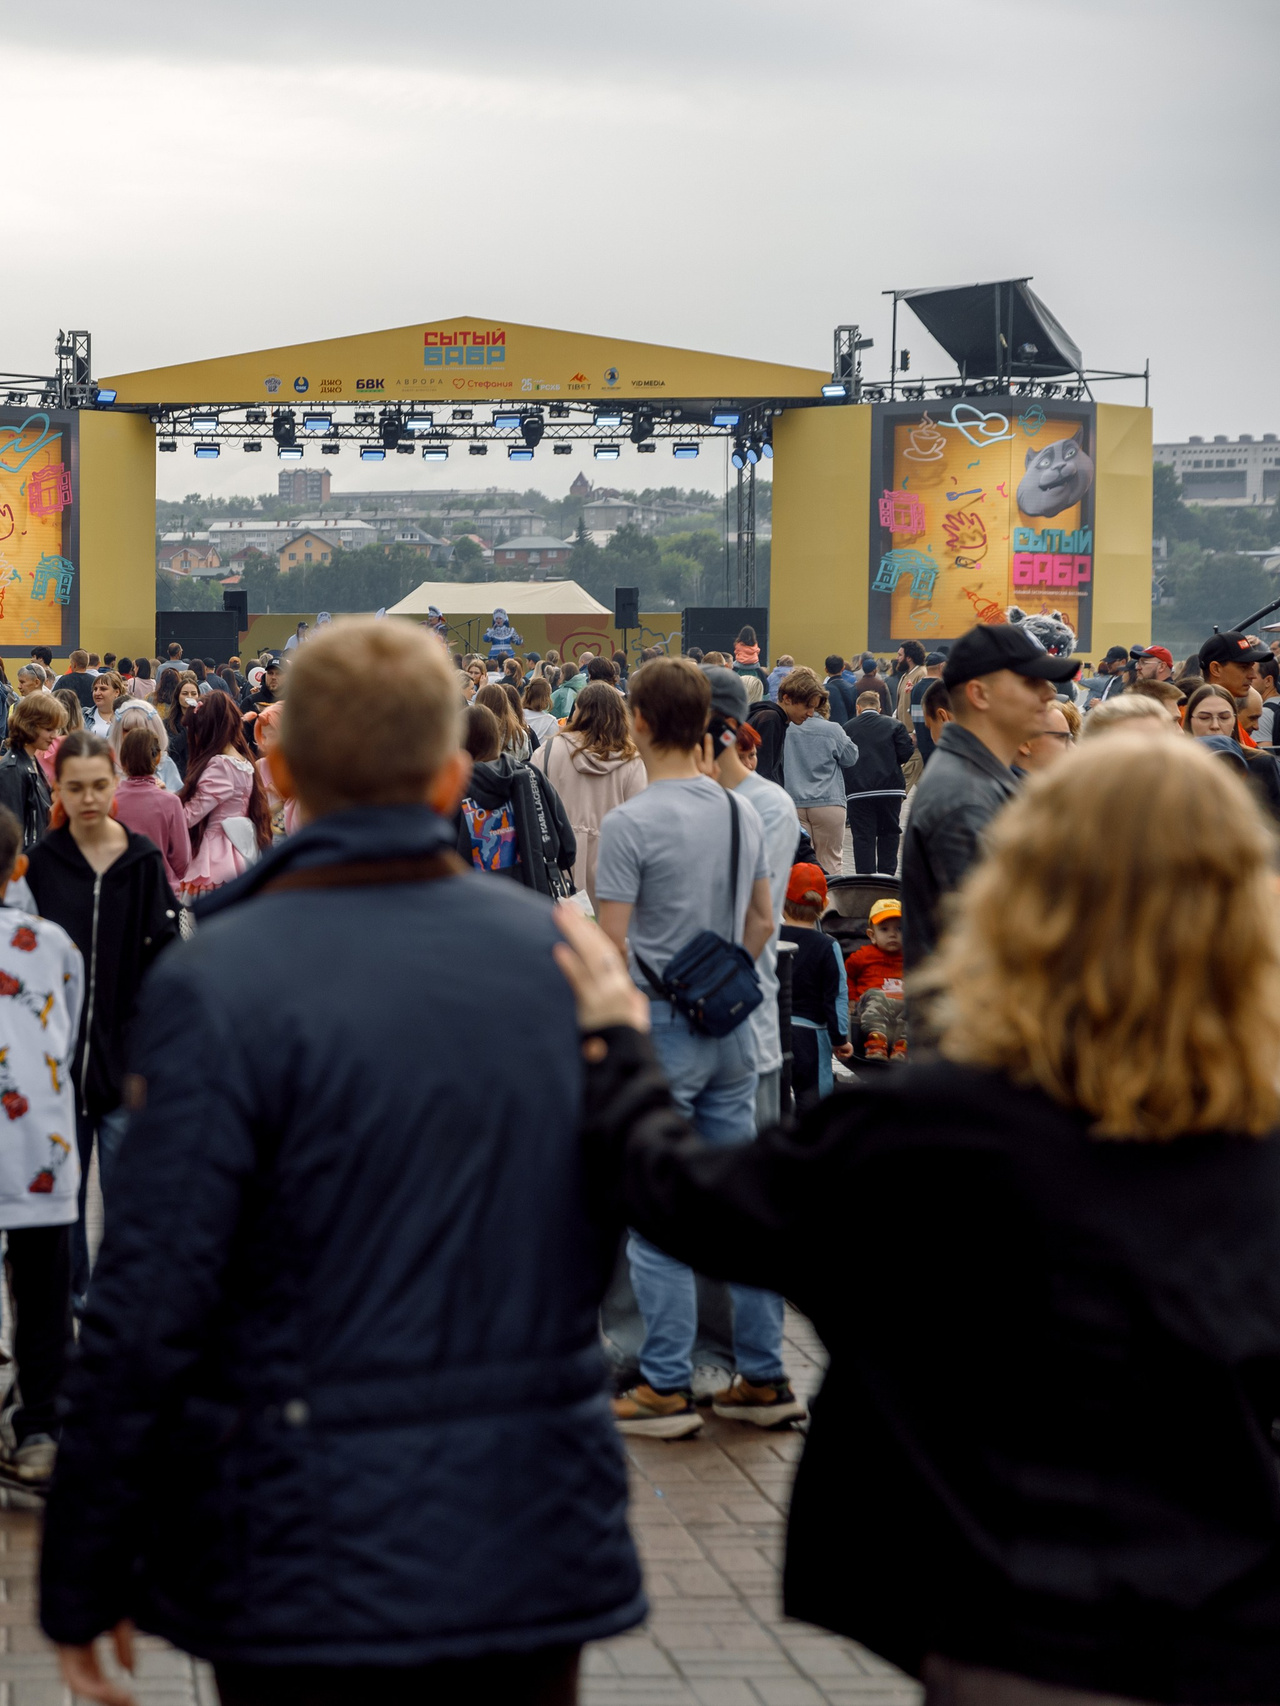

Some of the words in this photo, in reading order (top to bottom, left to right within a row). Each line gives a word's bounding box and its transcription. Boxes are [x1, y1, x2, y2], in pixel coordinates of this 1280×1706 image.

[424, 328, 506, 346] СЫТЫЙ
[424, 346, 506, 366] БАБР
[356, 379, 385, 389] БВК
[467, 380, 513, 389] Стефания
[1013, 525, 1092, 553] СЫТЫЙ
[1013, 552, 1091, 587] БАБР
[465, 808, 487, 824] TO
[538, 810, 549, 834] KARL
